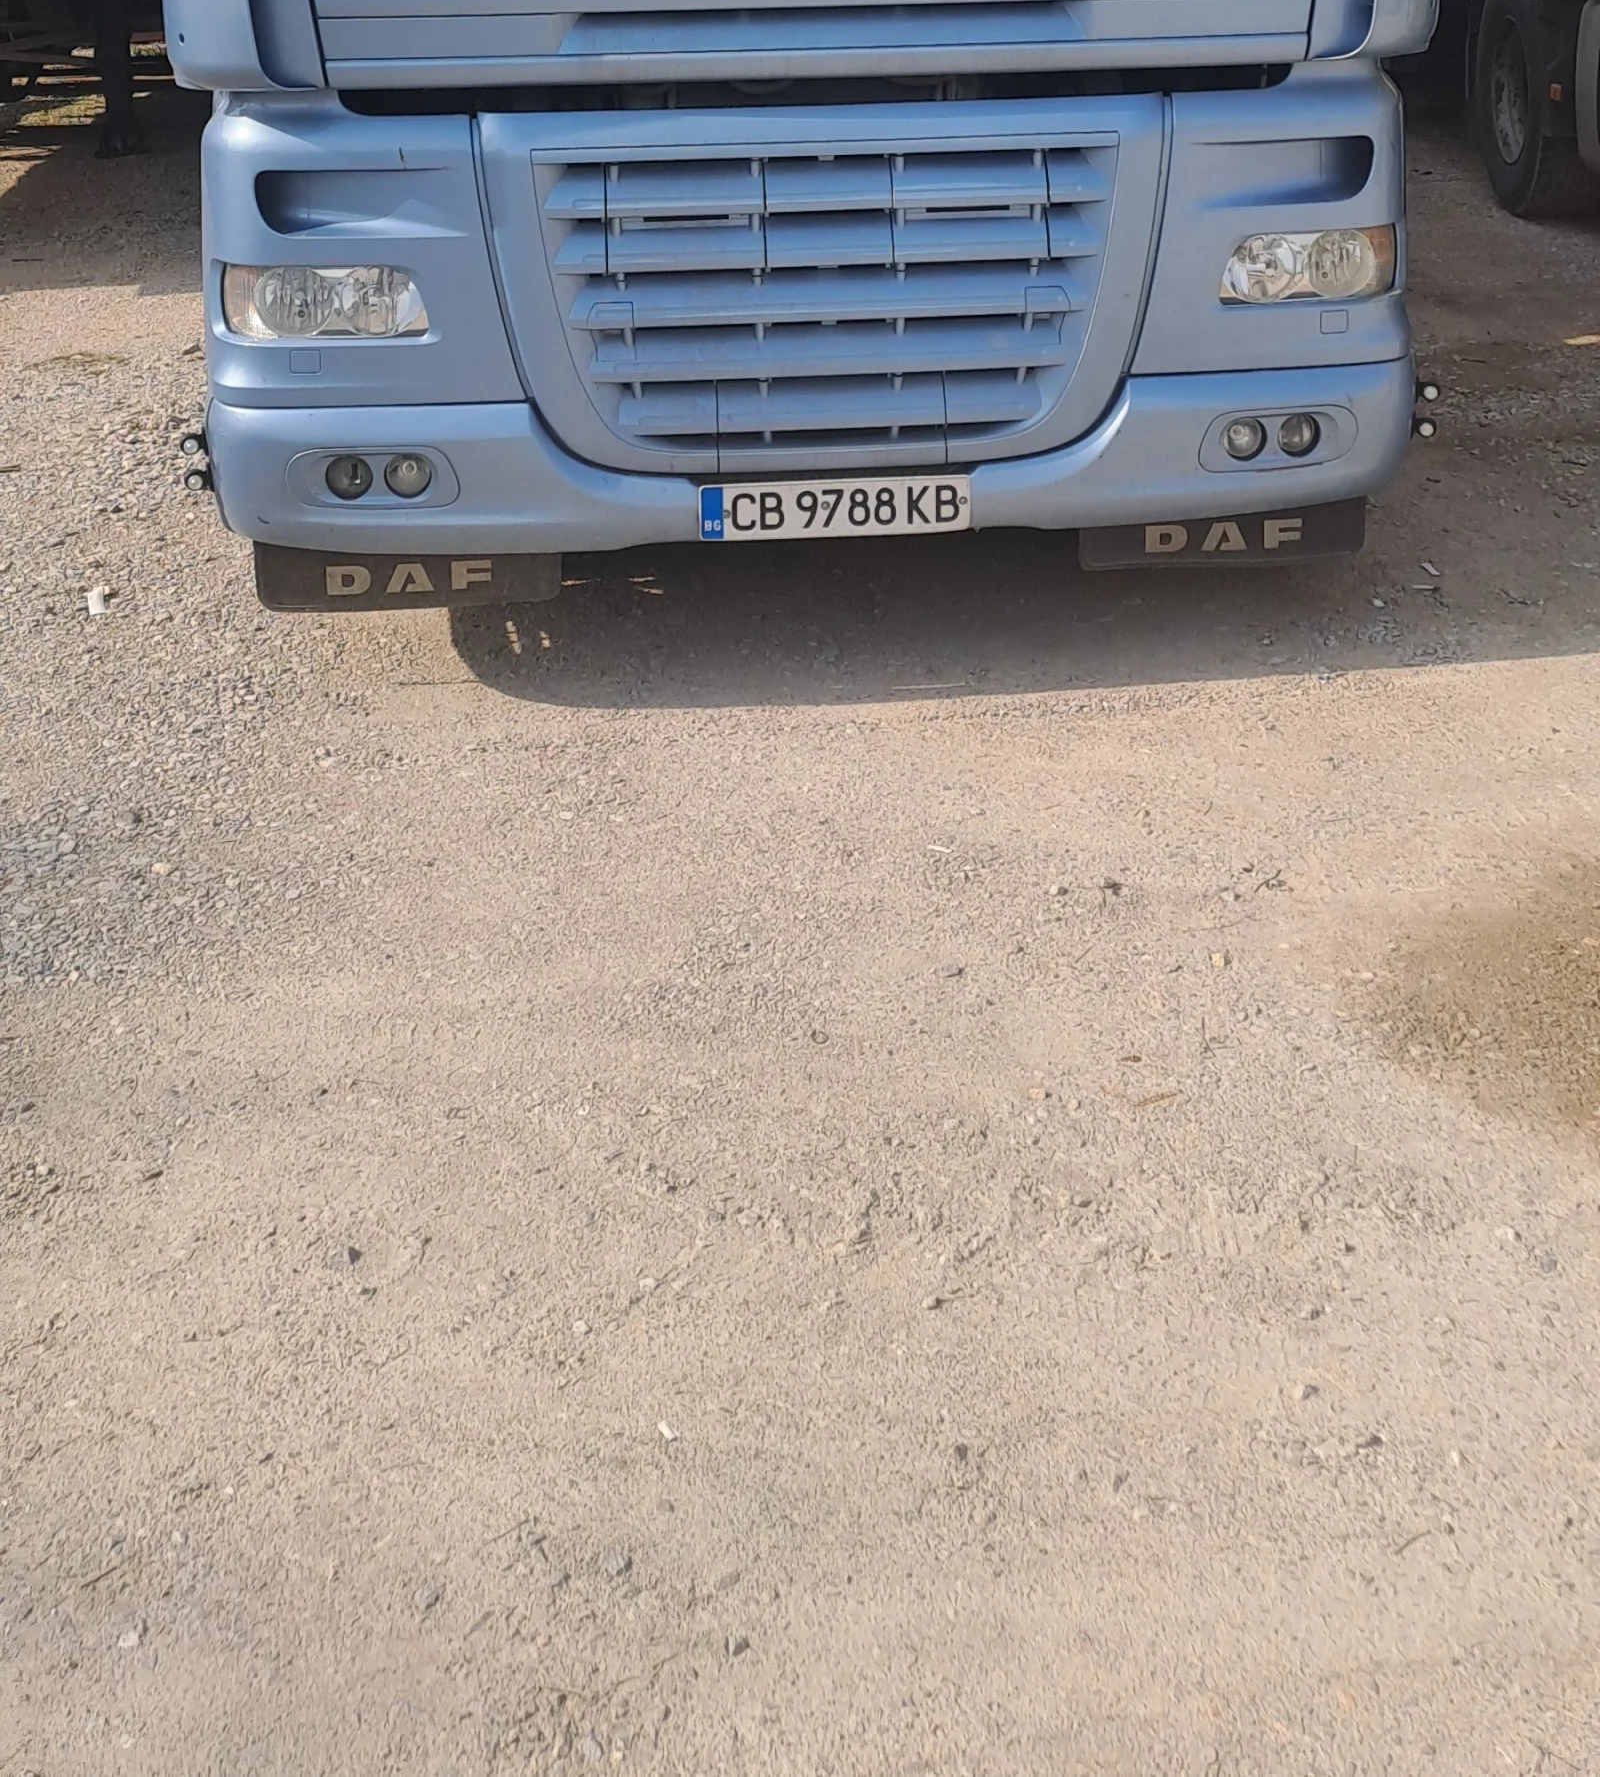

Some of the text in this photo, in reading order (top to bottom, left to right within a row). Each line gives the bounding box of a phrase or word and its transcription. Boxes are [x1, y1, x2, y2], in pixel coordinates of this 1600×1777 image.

[704, 520, 722, 532] BG
[731, 484, 961, 531] CB 9788 KB
[1144, 517, 1303, 554] DAF
[326, 559, 492, 596] DAF
